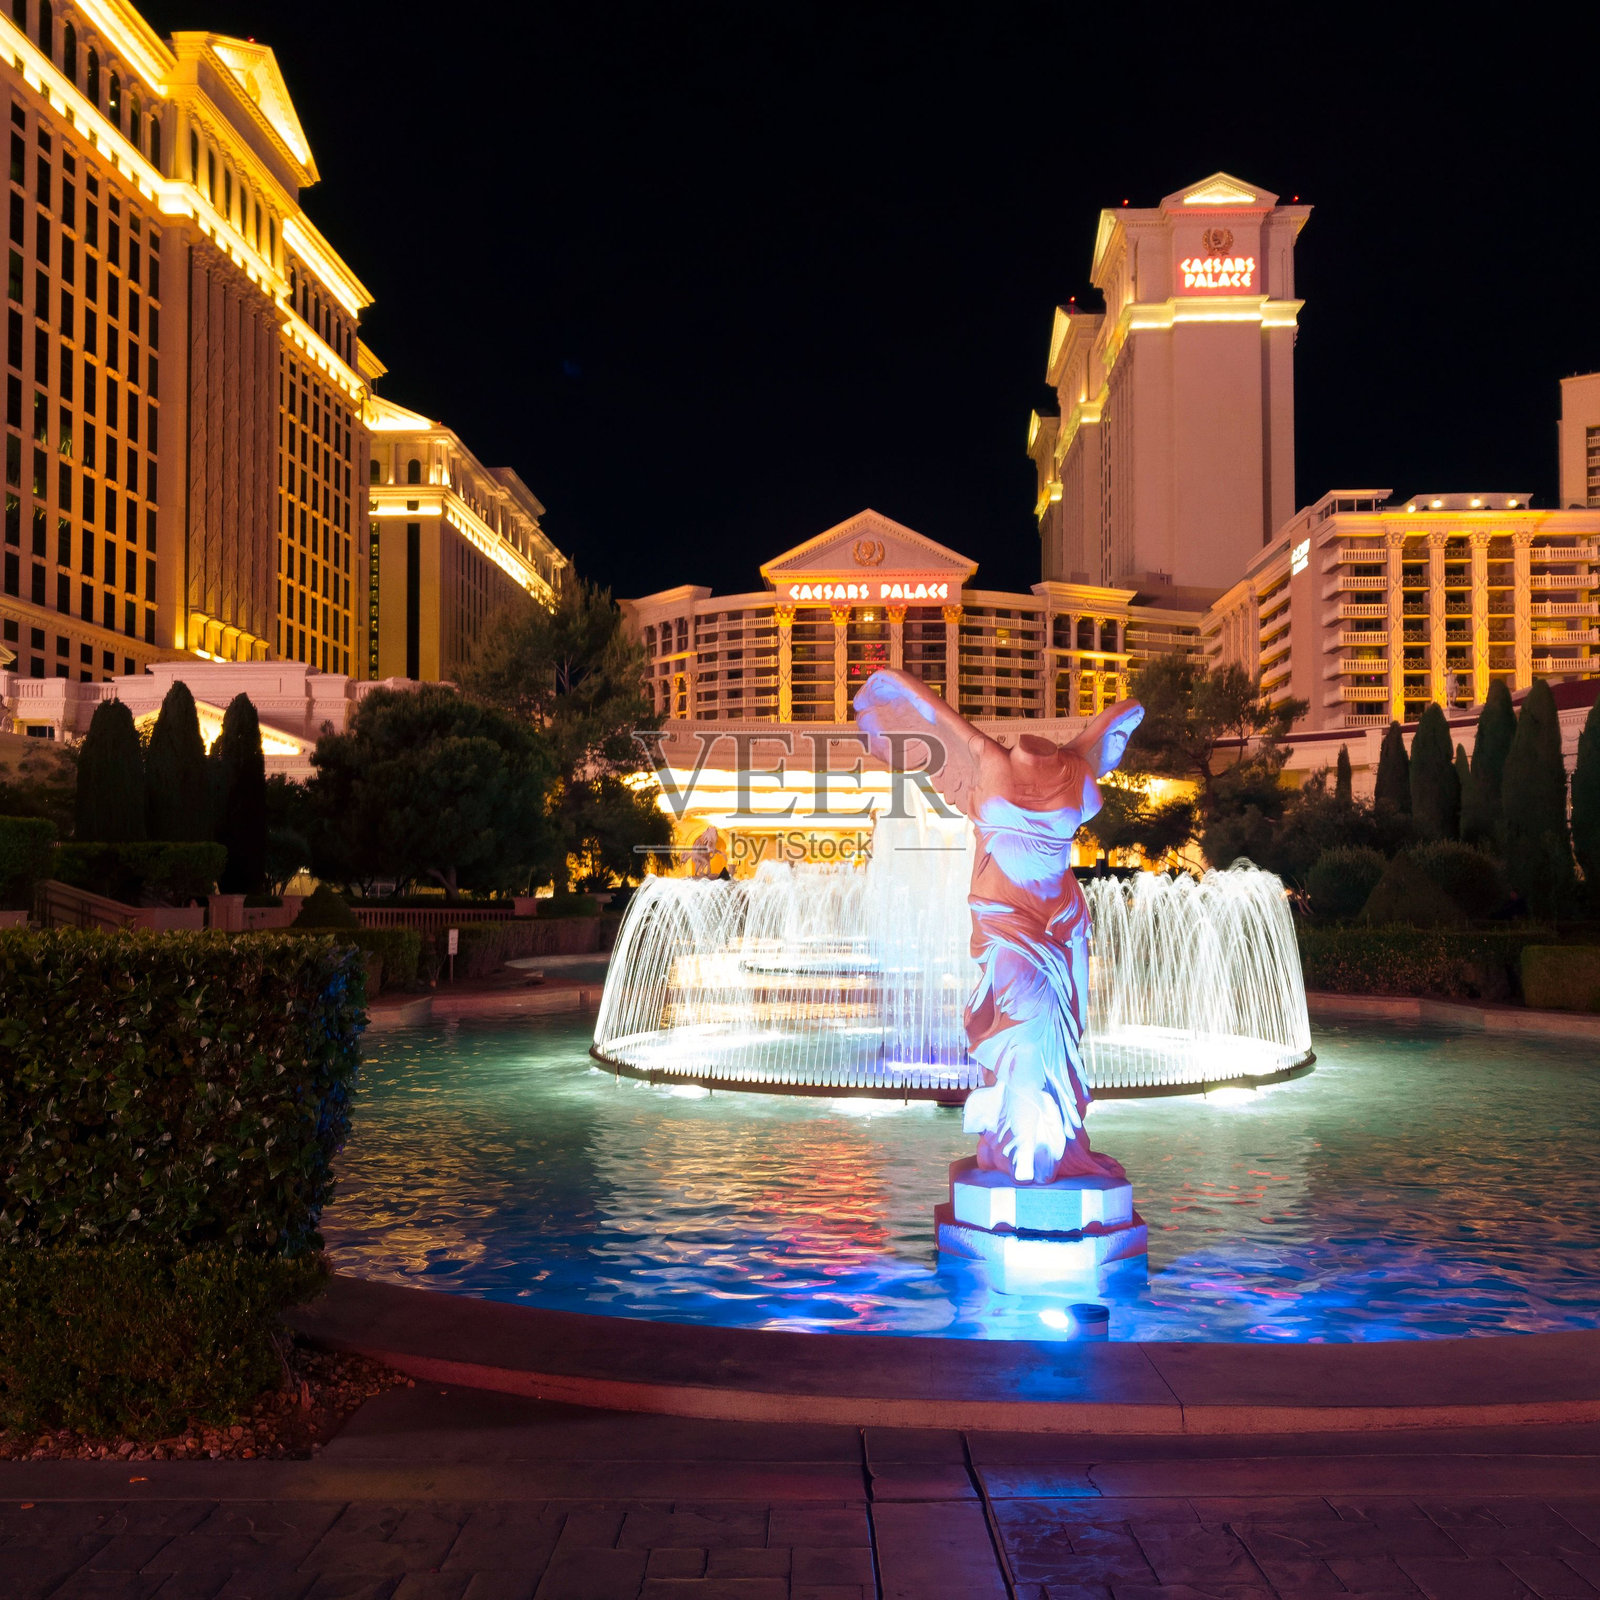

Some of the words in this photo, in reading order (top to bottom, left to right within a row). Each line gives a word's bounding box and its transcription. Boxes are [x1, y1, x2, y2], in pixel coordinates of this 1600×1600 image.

[1180, 257, 1256, 273] CAESARS
[1184, 272, 1251, 288] PALACE
[788, 584, 870, 600] CAESARS
[880, 583, 949, 599] PALACE
